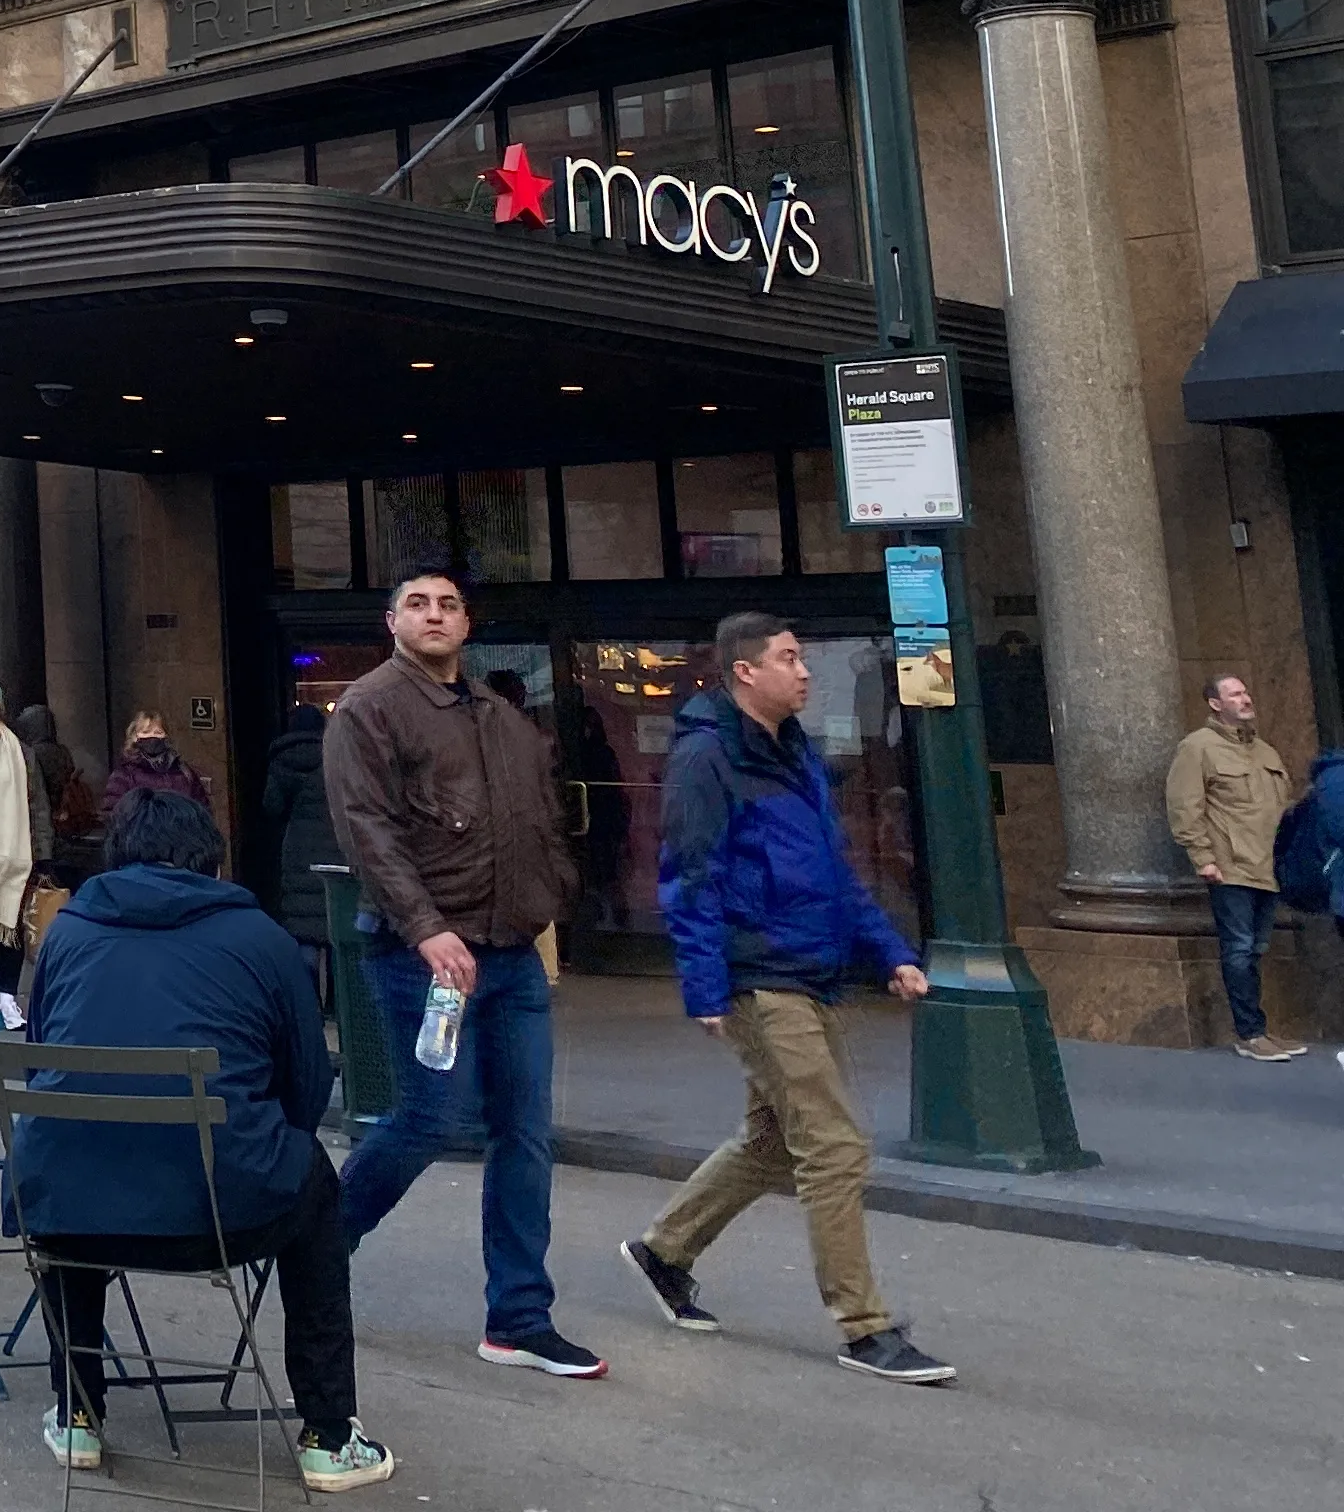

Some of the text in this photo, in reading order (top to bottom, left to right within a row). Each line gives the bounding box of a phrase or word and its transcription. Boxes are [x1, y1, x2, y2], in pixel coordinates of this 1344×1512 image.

[847, 390, 934, 406] Herald Square
[848, 408, 881, 421] Plaza
